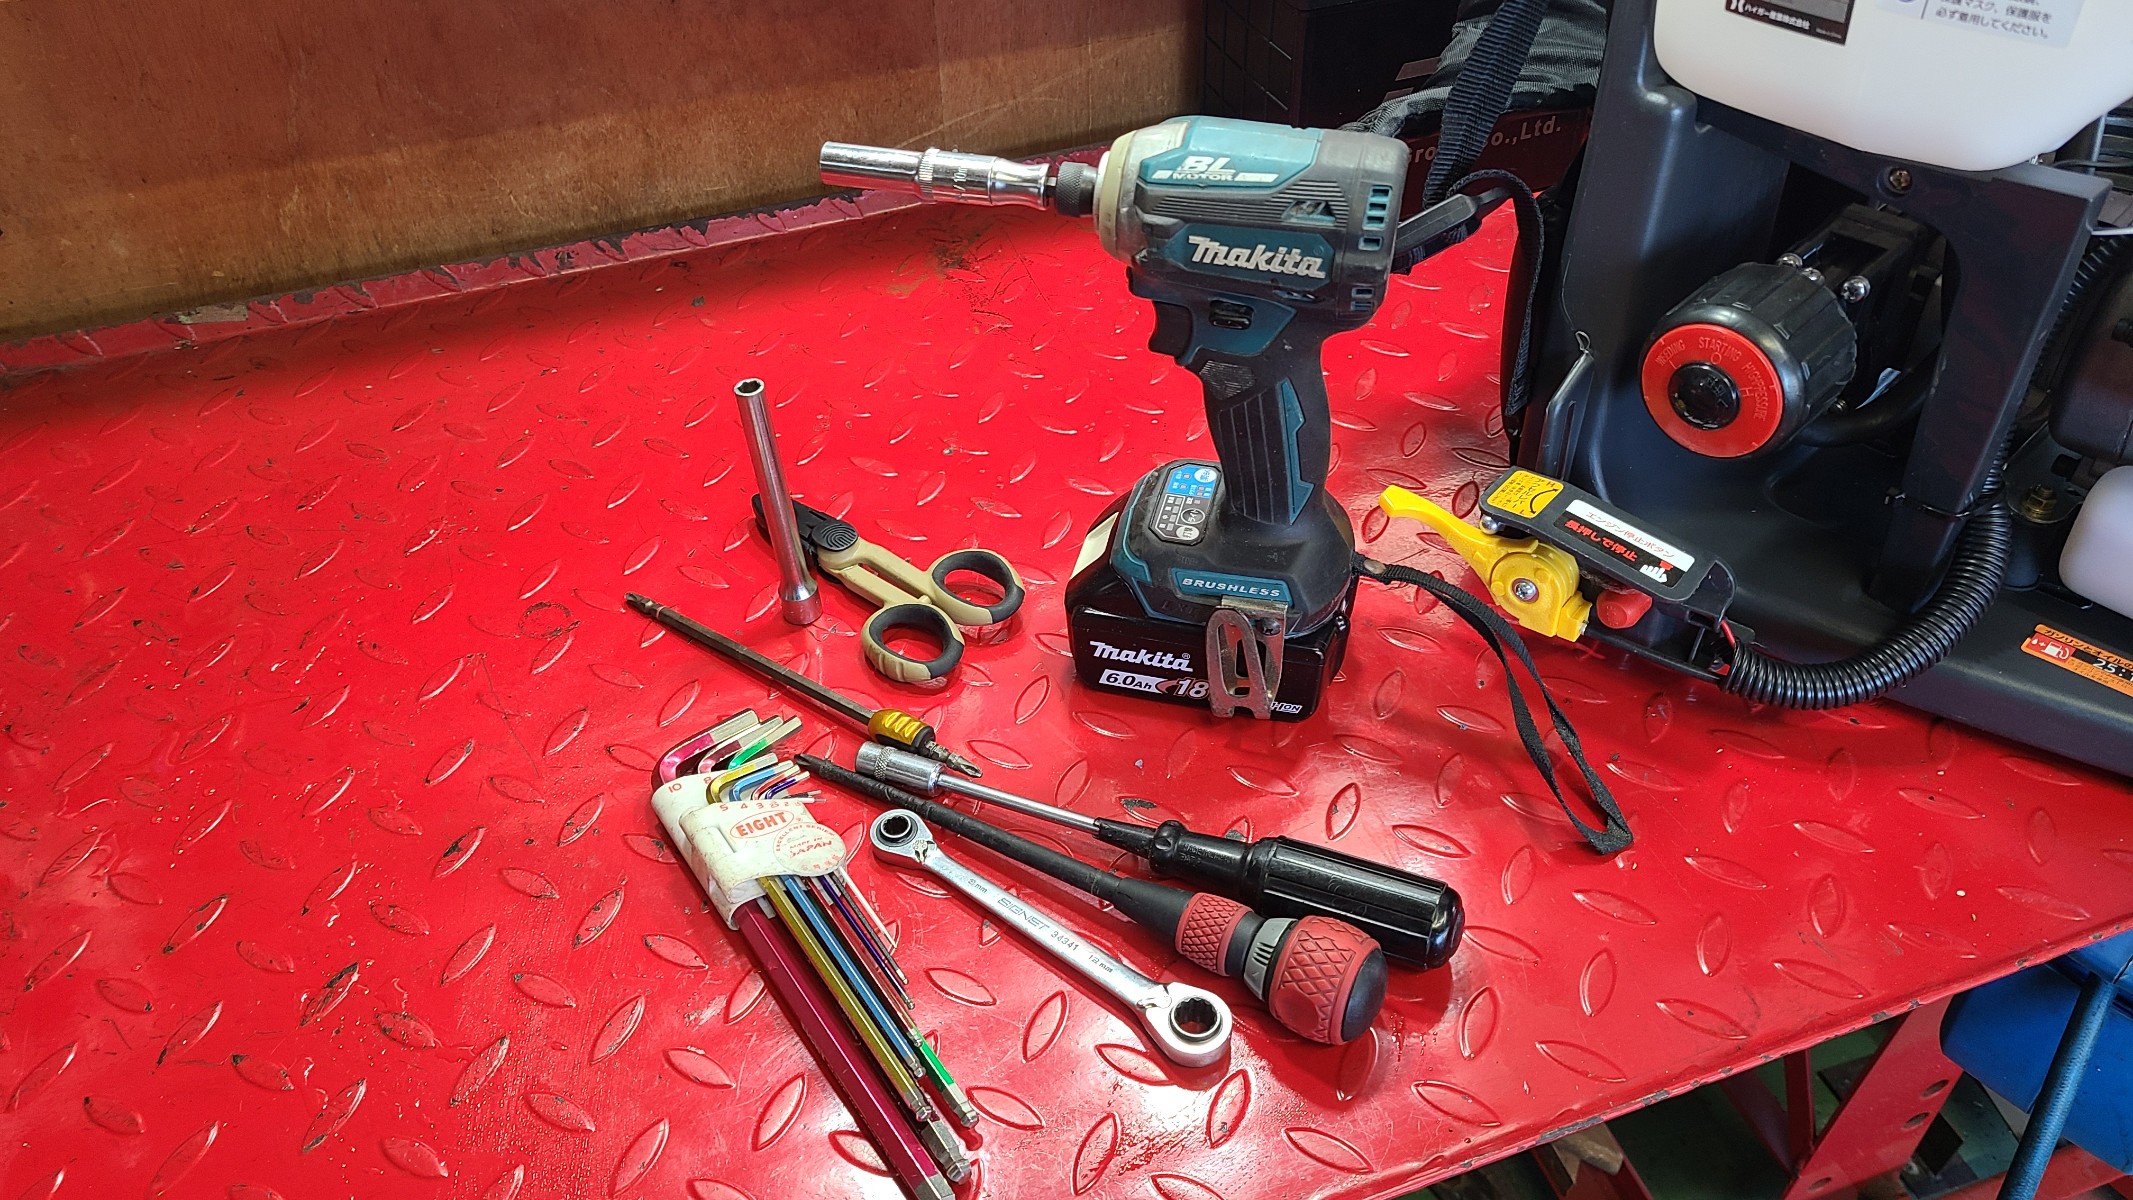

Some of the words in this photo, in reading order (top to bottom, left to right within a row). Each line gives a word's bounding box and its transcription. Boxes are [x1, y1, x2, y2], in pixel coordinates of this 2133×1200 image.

[1490, 116, 1561, 147] o.,Ltd.
[1176, 155, 1236, 174] BL
[1172, 172, 1235, 182] MOTOR
[1698, 336, 1742, 362] STARTING
[1564, 519, 1639, 562] 長押しで停止
[1585, 511, 1675, 558] エンジン停止ボタン
[1182, 577, 1281, 597] BRUSHLESS
[1105, 672, 1153, 691] 6.0Ah
[667, 782, 682, 794] 10
[735, 812, 787, 837] EIGHT
[790, 840, 833, 859] JAPAN
[997, 897, 1050, 930] SIGNET
[1051, 931, 1080, 951] 34341
